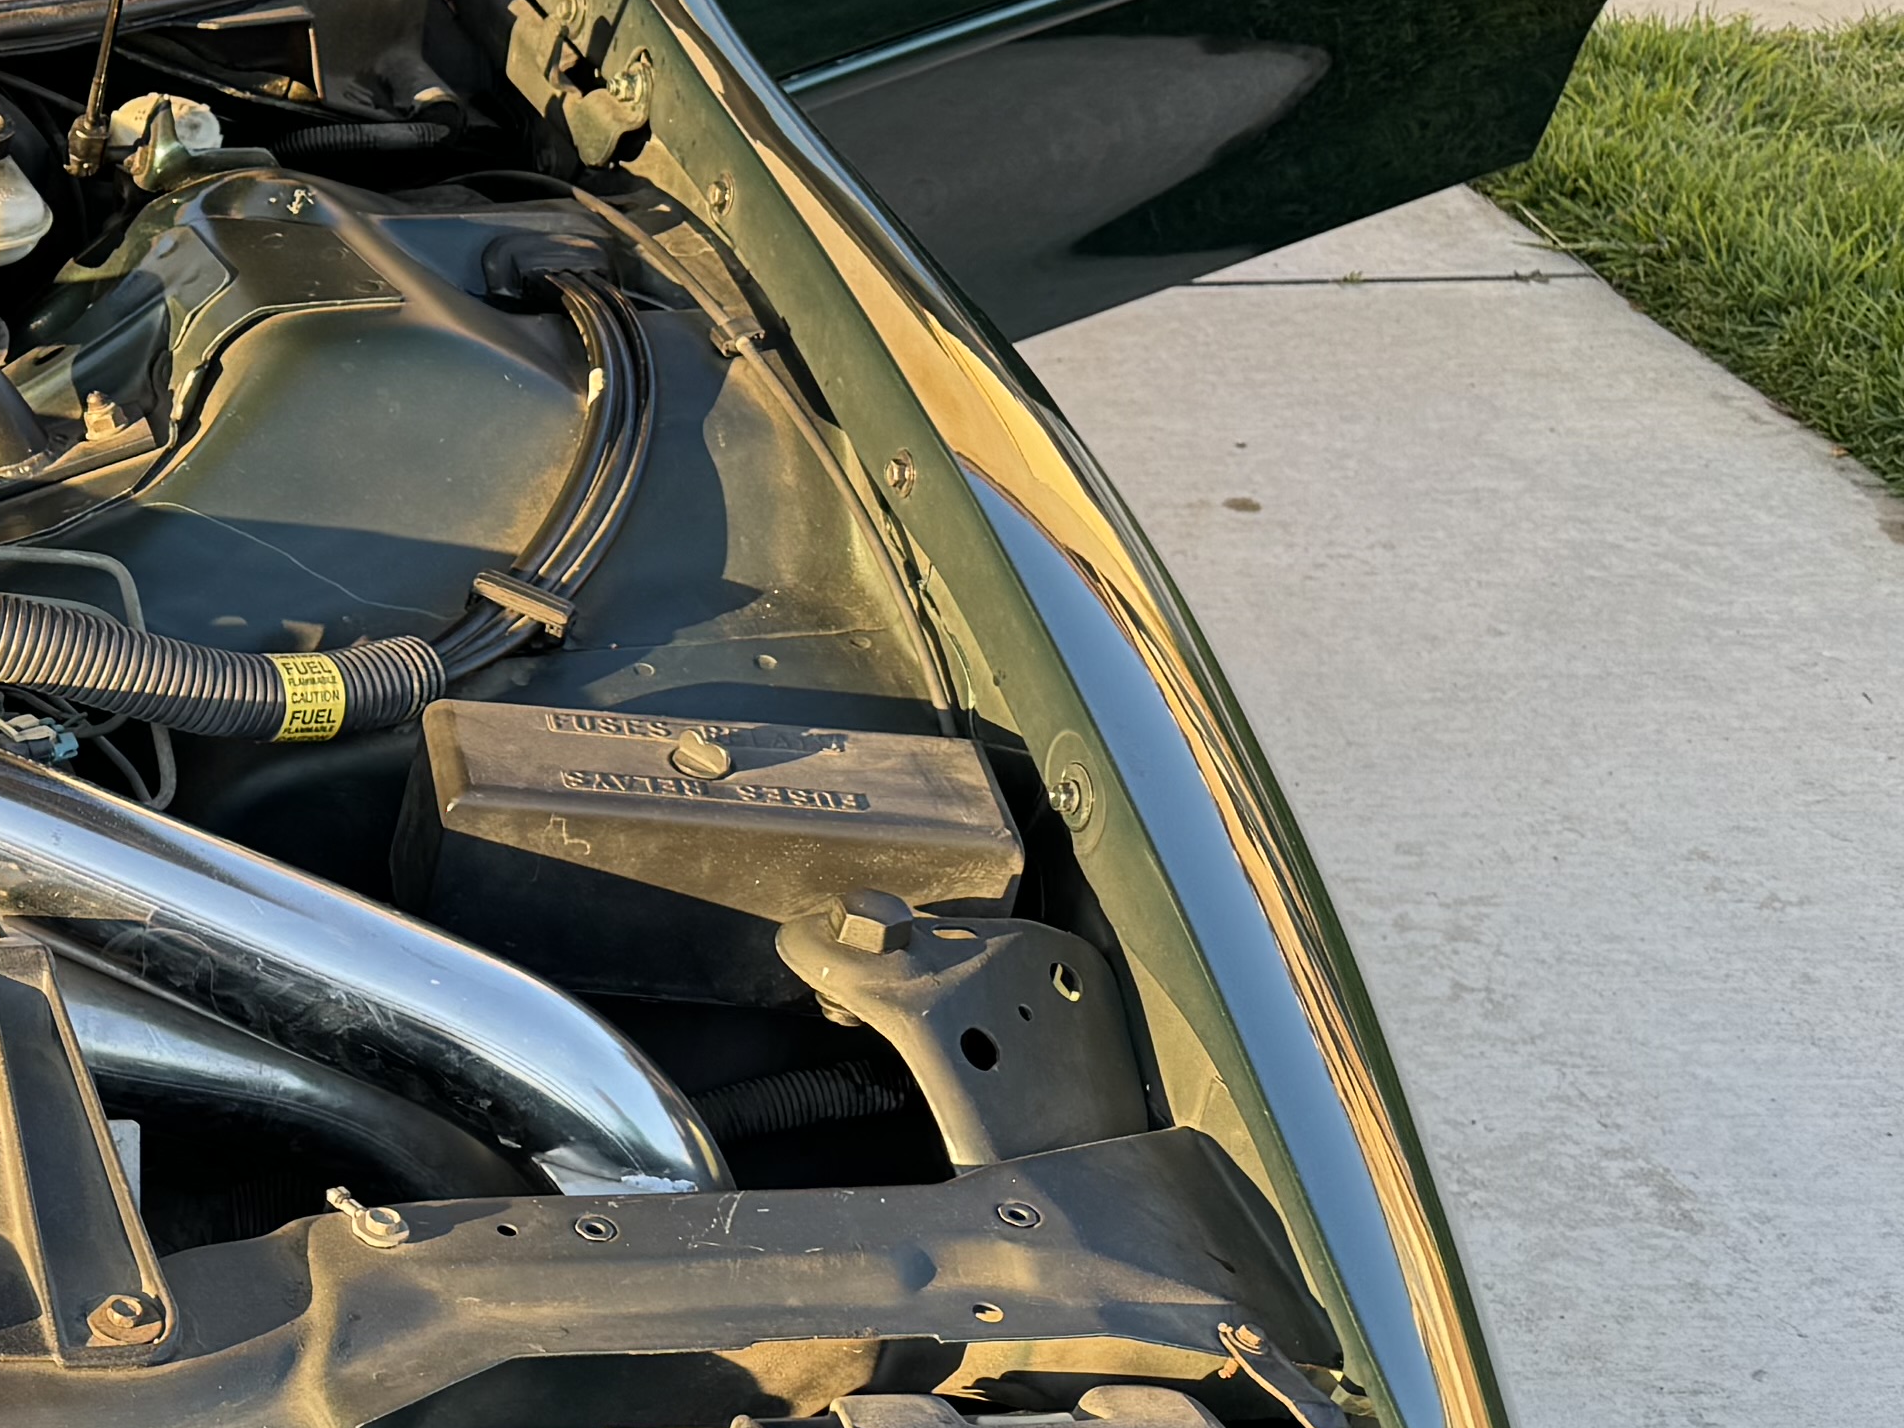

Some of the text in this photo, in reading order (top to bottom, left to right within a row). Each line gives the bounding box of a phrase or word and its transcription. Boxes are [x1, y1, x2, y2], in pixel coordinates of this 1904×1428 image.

[281, 661, 332, 675] FUEL
[291, 690, 340, 704] CAUTION
[289, 709, 336, 726] FUEL
[550, 714, 672, 737] FUSES
[562, 771, 867, 812] FUSES RELAYS
